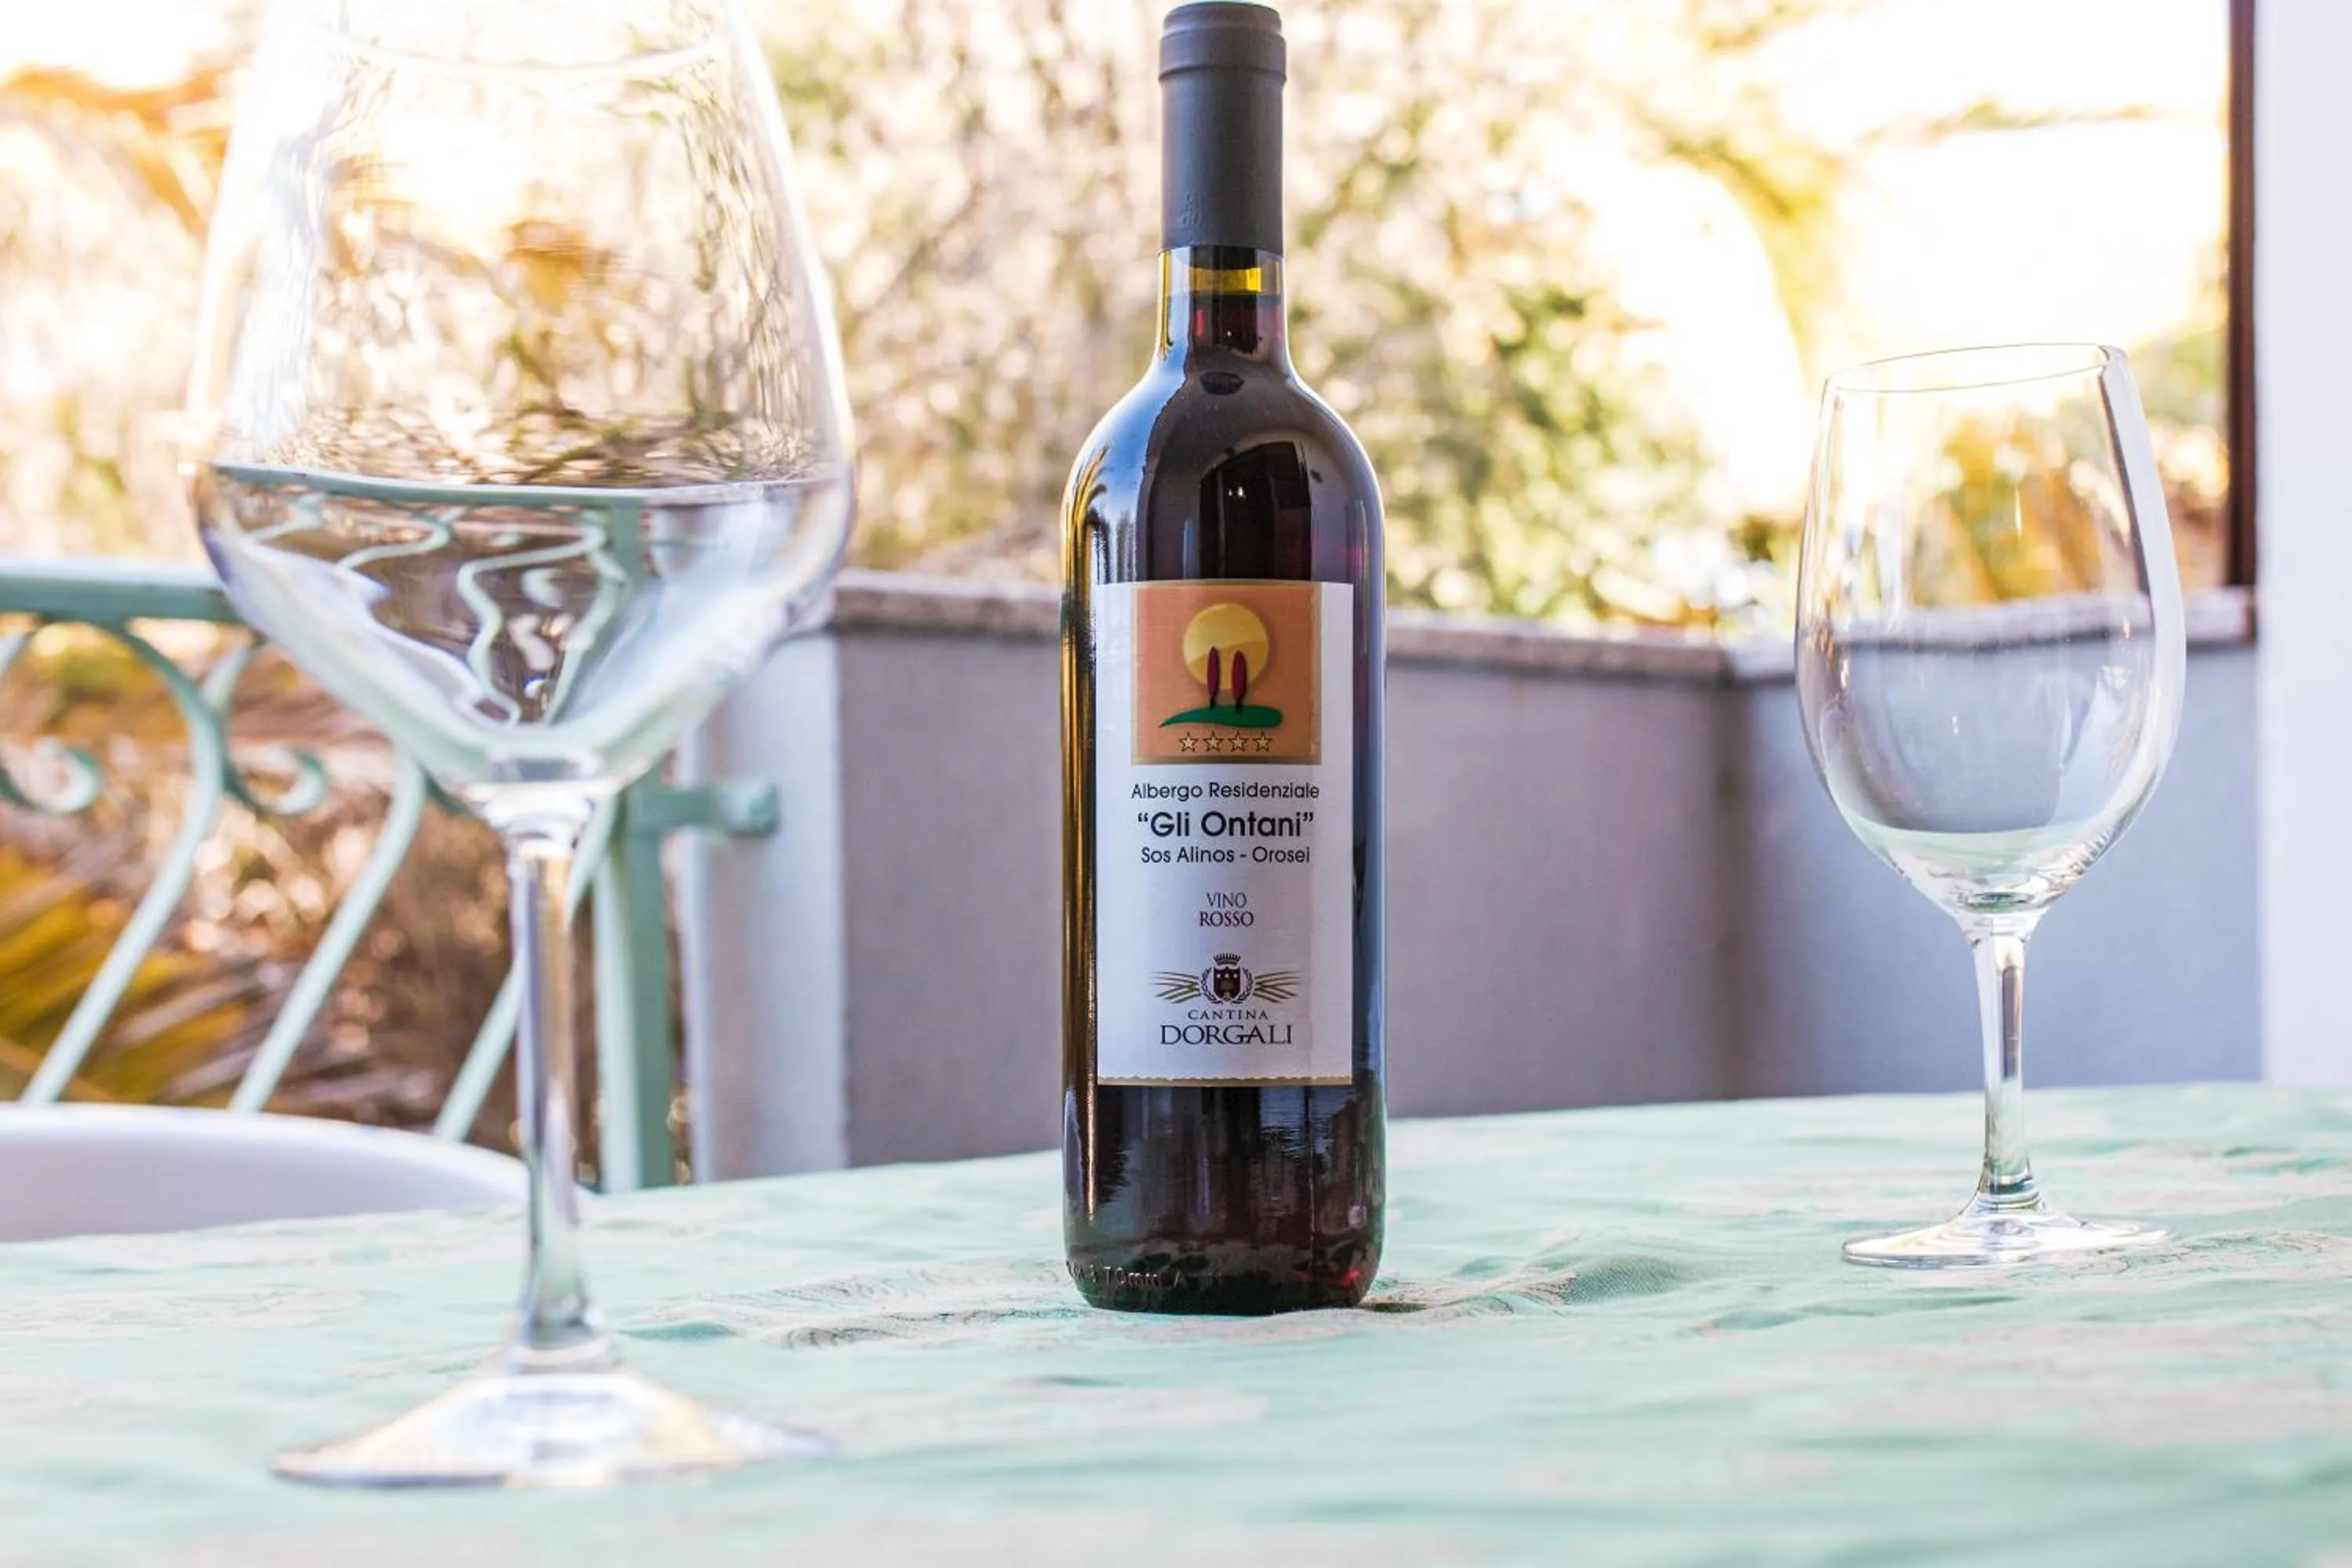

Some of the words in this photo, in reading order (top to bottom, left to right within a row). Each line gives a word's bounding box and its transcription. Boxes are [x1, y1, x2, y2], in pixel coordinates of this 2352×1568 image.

[1131, 783, 1203, 802] Albergo
[1209, 782, 1319, 799] Residenziale
[1138, 811, 1190, 837] “Gli
[1201, 811, 1314, 837] Ontani”
[1141, 846, 1171, 863] Sos
[1178, 846, 1235, 863] Alinos
[1252, 846, 1310, 863] Orosei
[1206, 892, 1247, 908] VINO
[1200, 911, 1254, 927] ROSSO
[1188, 1009, 1268, 1020] CANTINA
[1160, 1025, 1293, 1045] DORGALI
